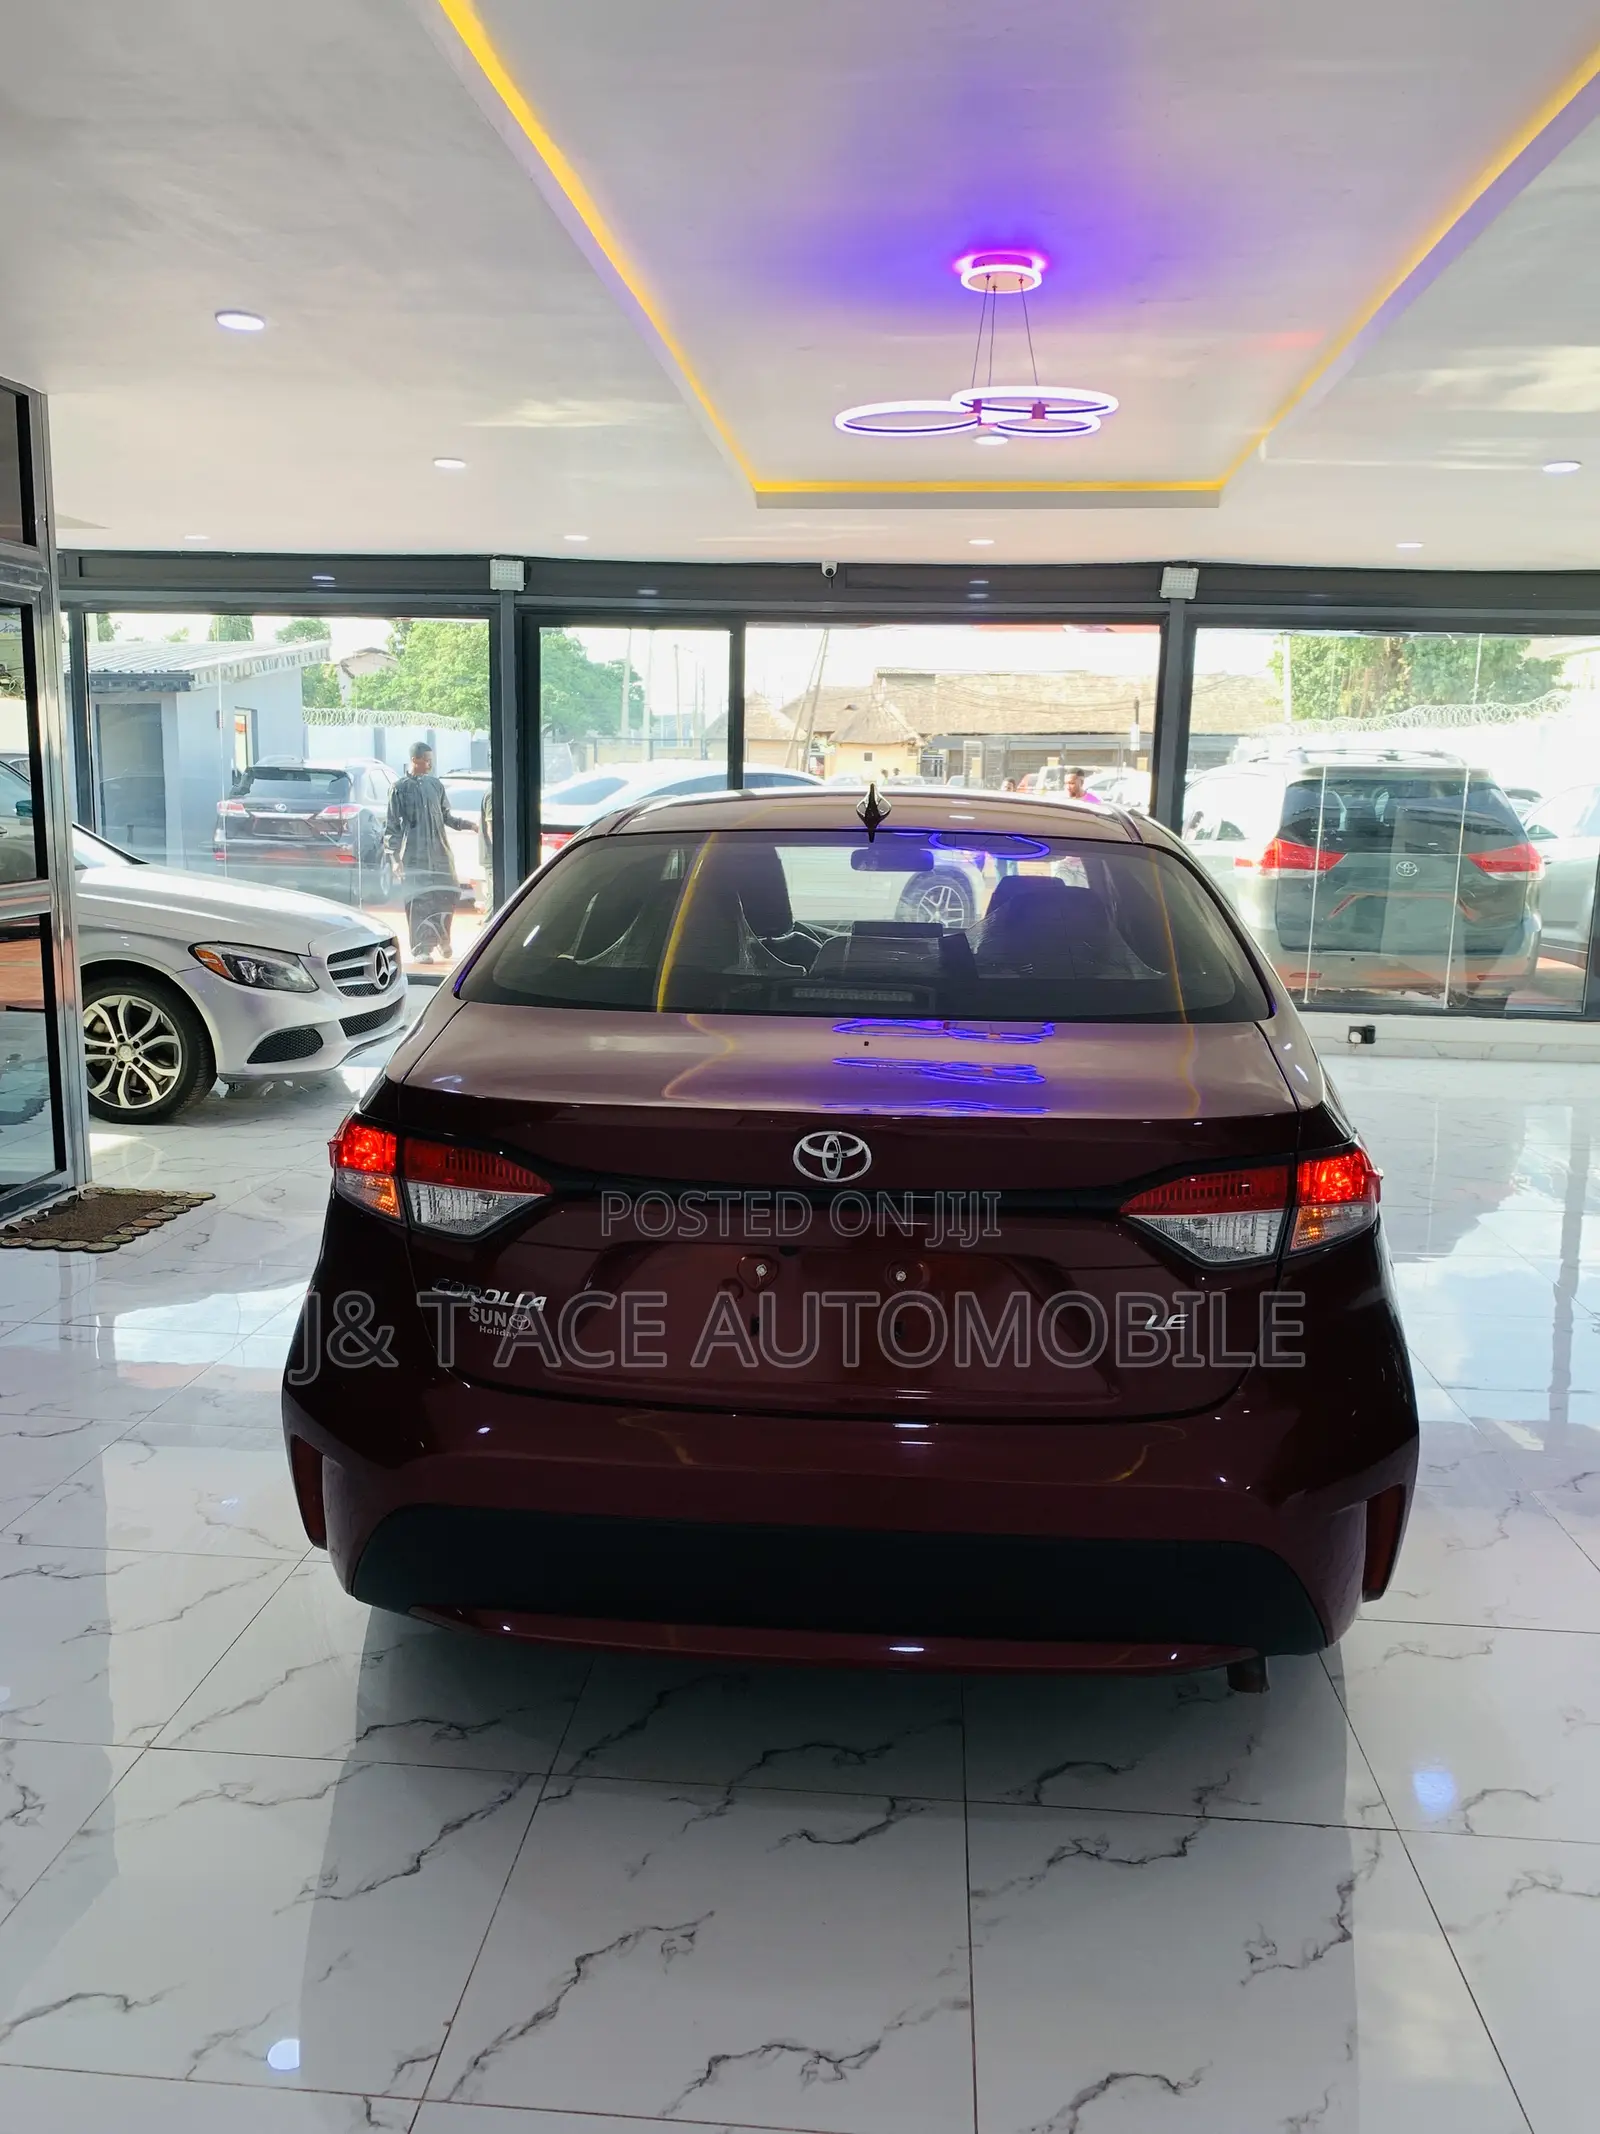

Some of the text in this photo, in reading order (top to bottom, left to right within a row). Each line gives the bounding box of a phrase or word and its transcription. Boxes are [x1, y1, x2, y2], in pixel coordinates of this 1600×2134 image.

[431, 1278, 548, 1312] COROLLA
[1144, 1313, 1190, 1331] LE
[479, 1325, 519, 1340] Holiday
